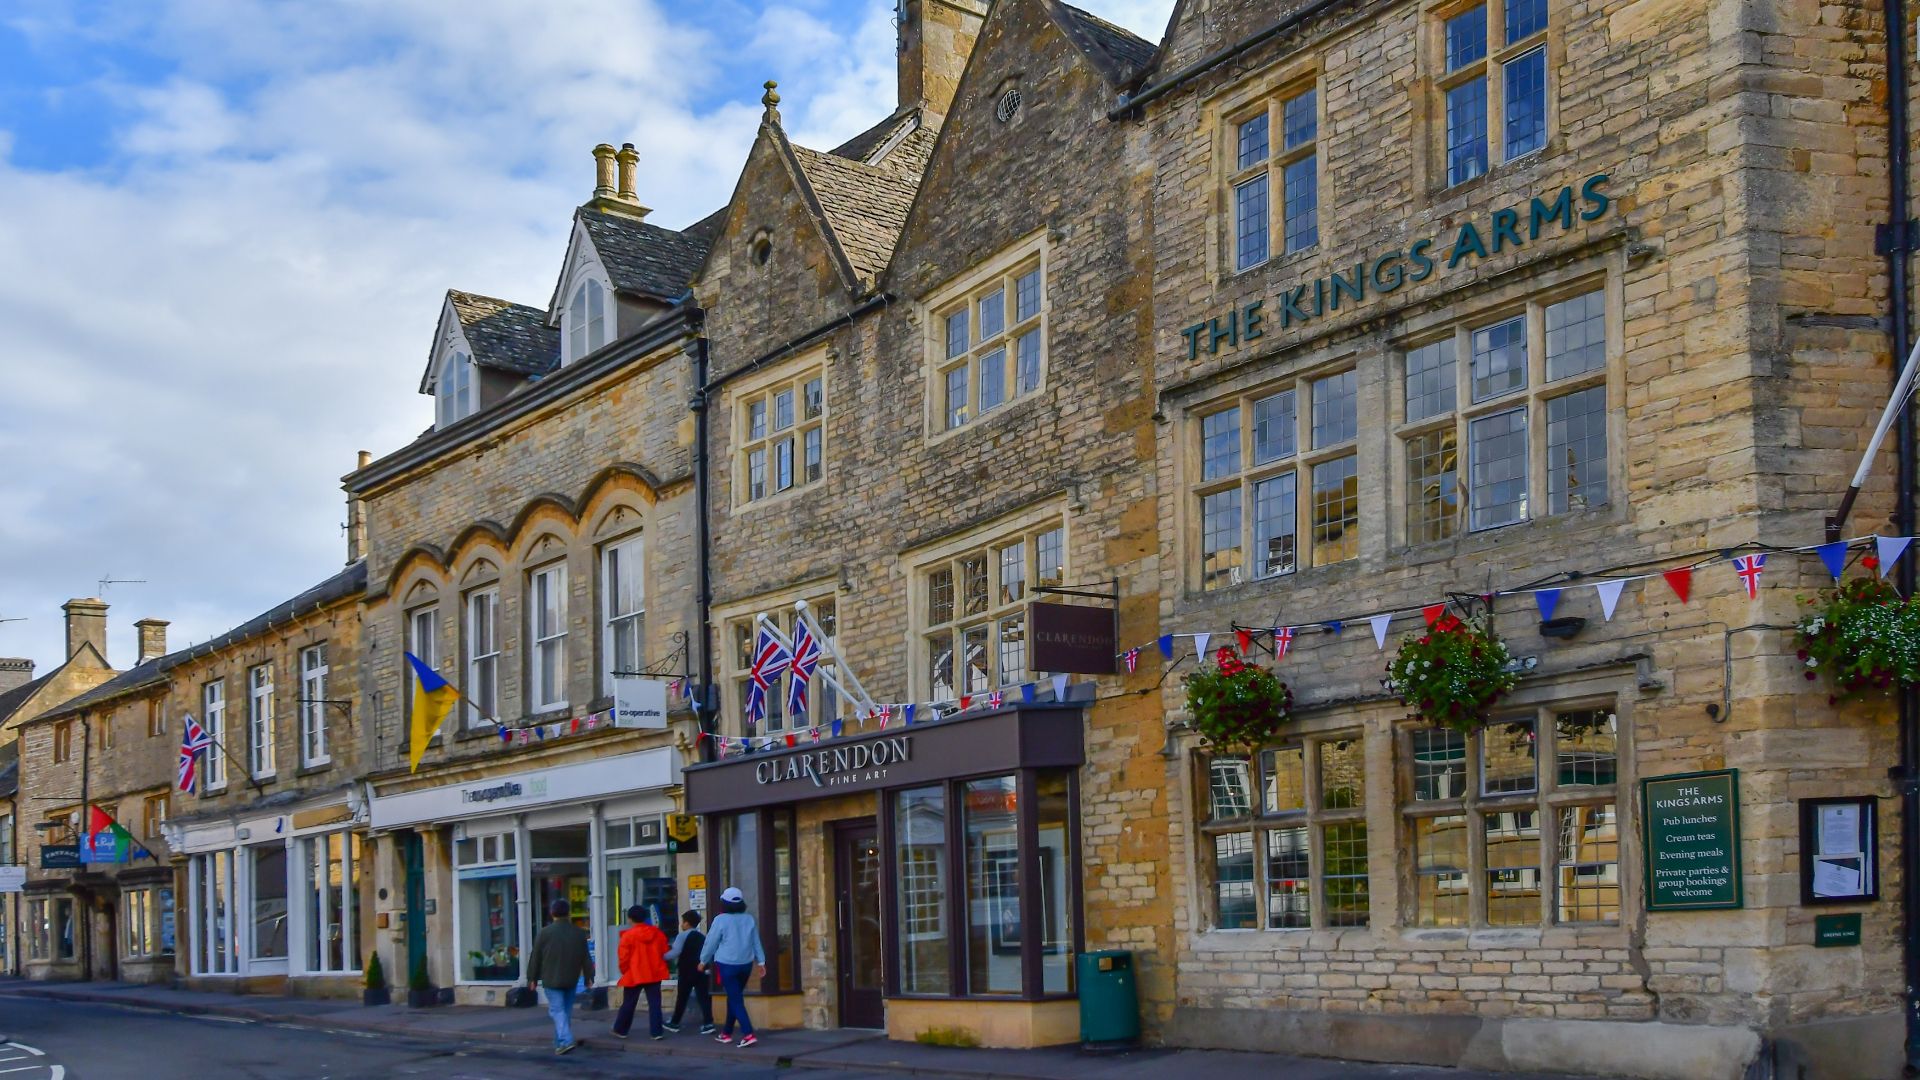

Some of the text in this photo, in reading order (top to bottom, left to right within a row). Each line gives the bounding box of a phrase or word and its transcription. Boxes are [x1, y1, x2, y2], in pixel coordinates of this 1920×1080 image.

[1181, 174, 1611, 361] THE KINGS ARMS
[756, 736, 911, 788] CLARENDON
[830, 769, 888, 787] FINE ART
[1678, 787, 1700, 797] THE
[1656, 795, 1723, 809] KINGS ARMS
[1663, 814, 1717, 826] Pub lunches
[1665, 833, 1716, 843] Cream teas
[1660, 847, 1724, 860] Evening meals
[1656, 866, 1729, 878] Private parties &
[1658, 877, 1727, 889] group bookings
[1672, 888, 1713, 897] welcome
